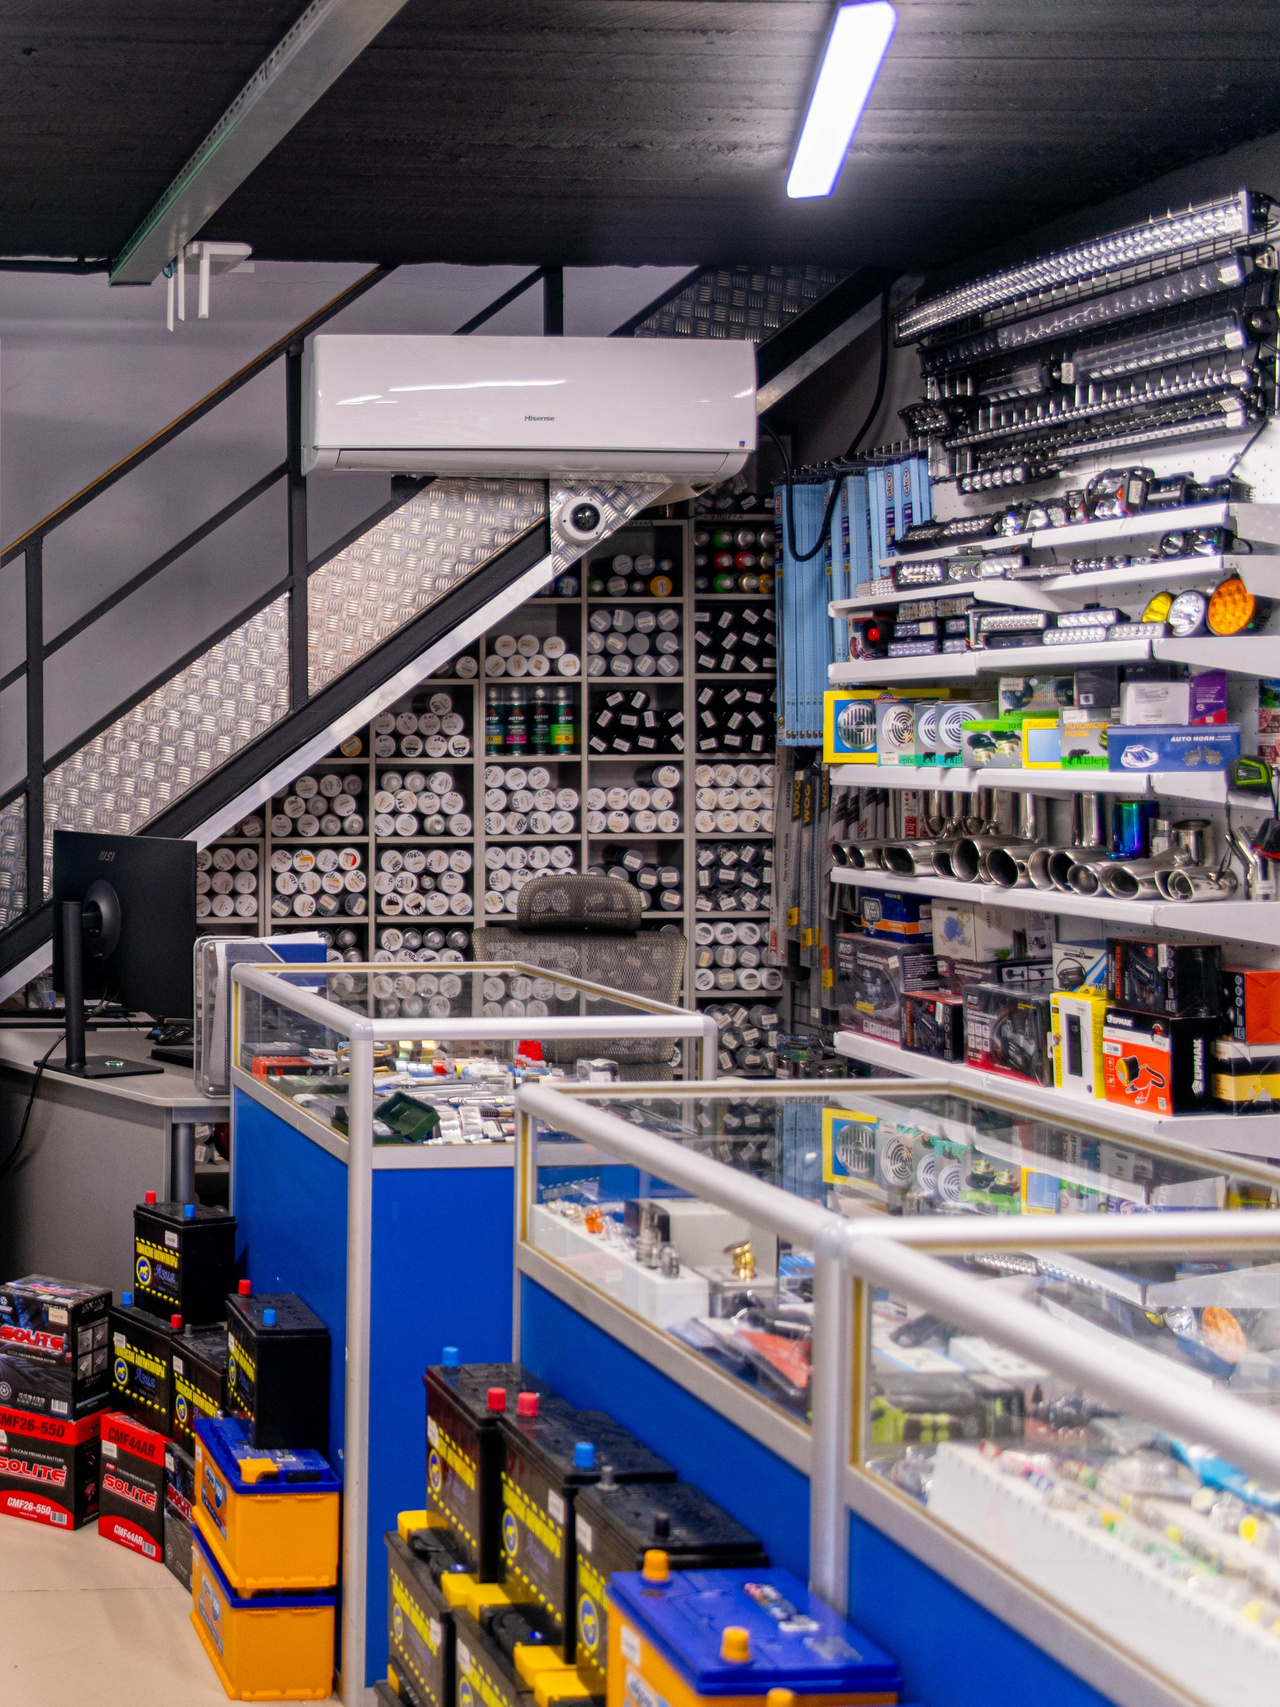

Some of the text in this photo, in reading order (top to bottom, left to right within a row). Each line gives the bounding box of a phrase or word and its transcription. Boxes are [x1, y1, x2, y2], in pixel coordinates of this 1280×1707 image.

[524, 414, 555, 423] Hisense
[1064, 730, 1090, 739] HORN
[1170, 735, 1191, 743] AUTO
[792, 779, 801, 817] WOG
[803, 784, 811, 823] WOG
[1193, 1038, 1204, 1082] ЕРМАК
[153, 1264, 176, 1284] Азия
[0, 1325, 65, 1353] SOLITE
[133, 1367, 156, 1389] Азия
[107, 1426, 156, 1459] CMF44AR
[10, 1447, 28, 1455] CALCIUM
[28, 1450, 46, 1459] PREMIUM
[46, 1454, 65, 1463] BATTERY
[102, 1473, 158, 1512] SOLITE
[166, 1483, 196, 1523] SOLIT
[6, 1496, 52, 1515] CMF26-550
[113, 1524, 144, 1546] CMF44AR
